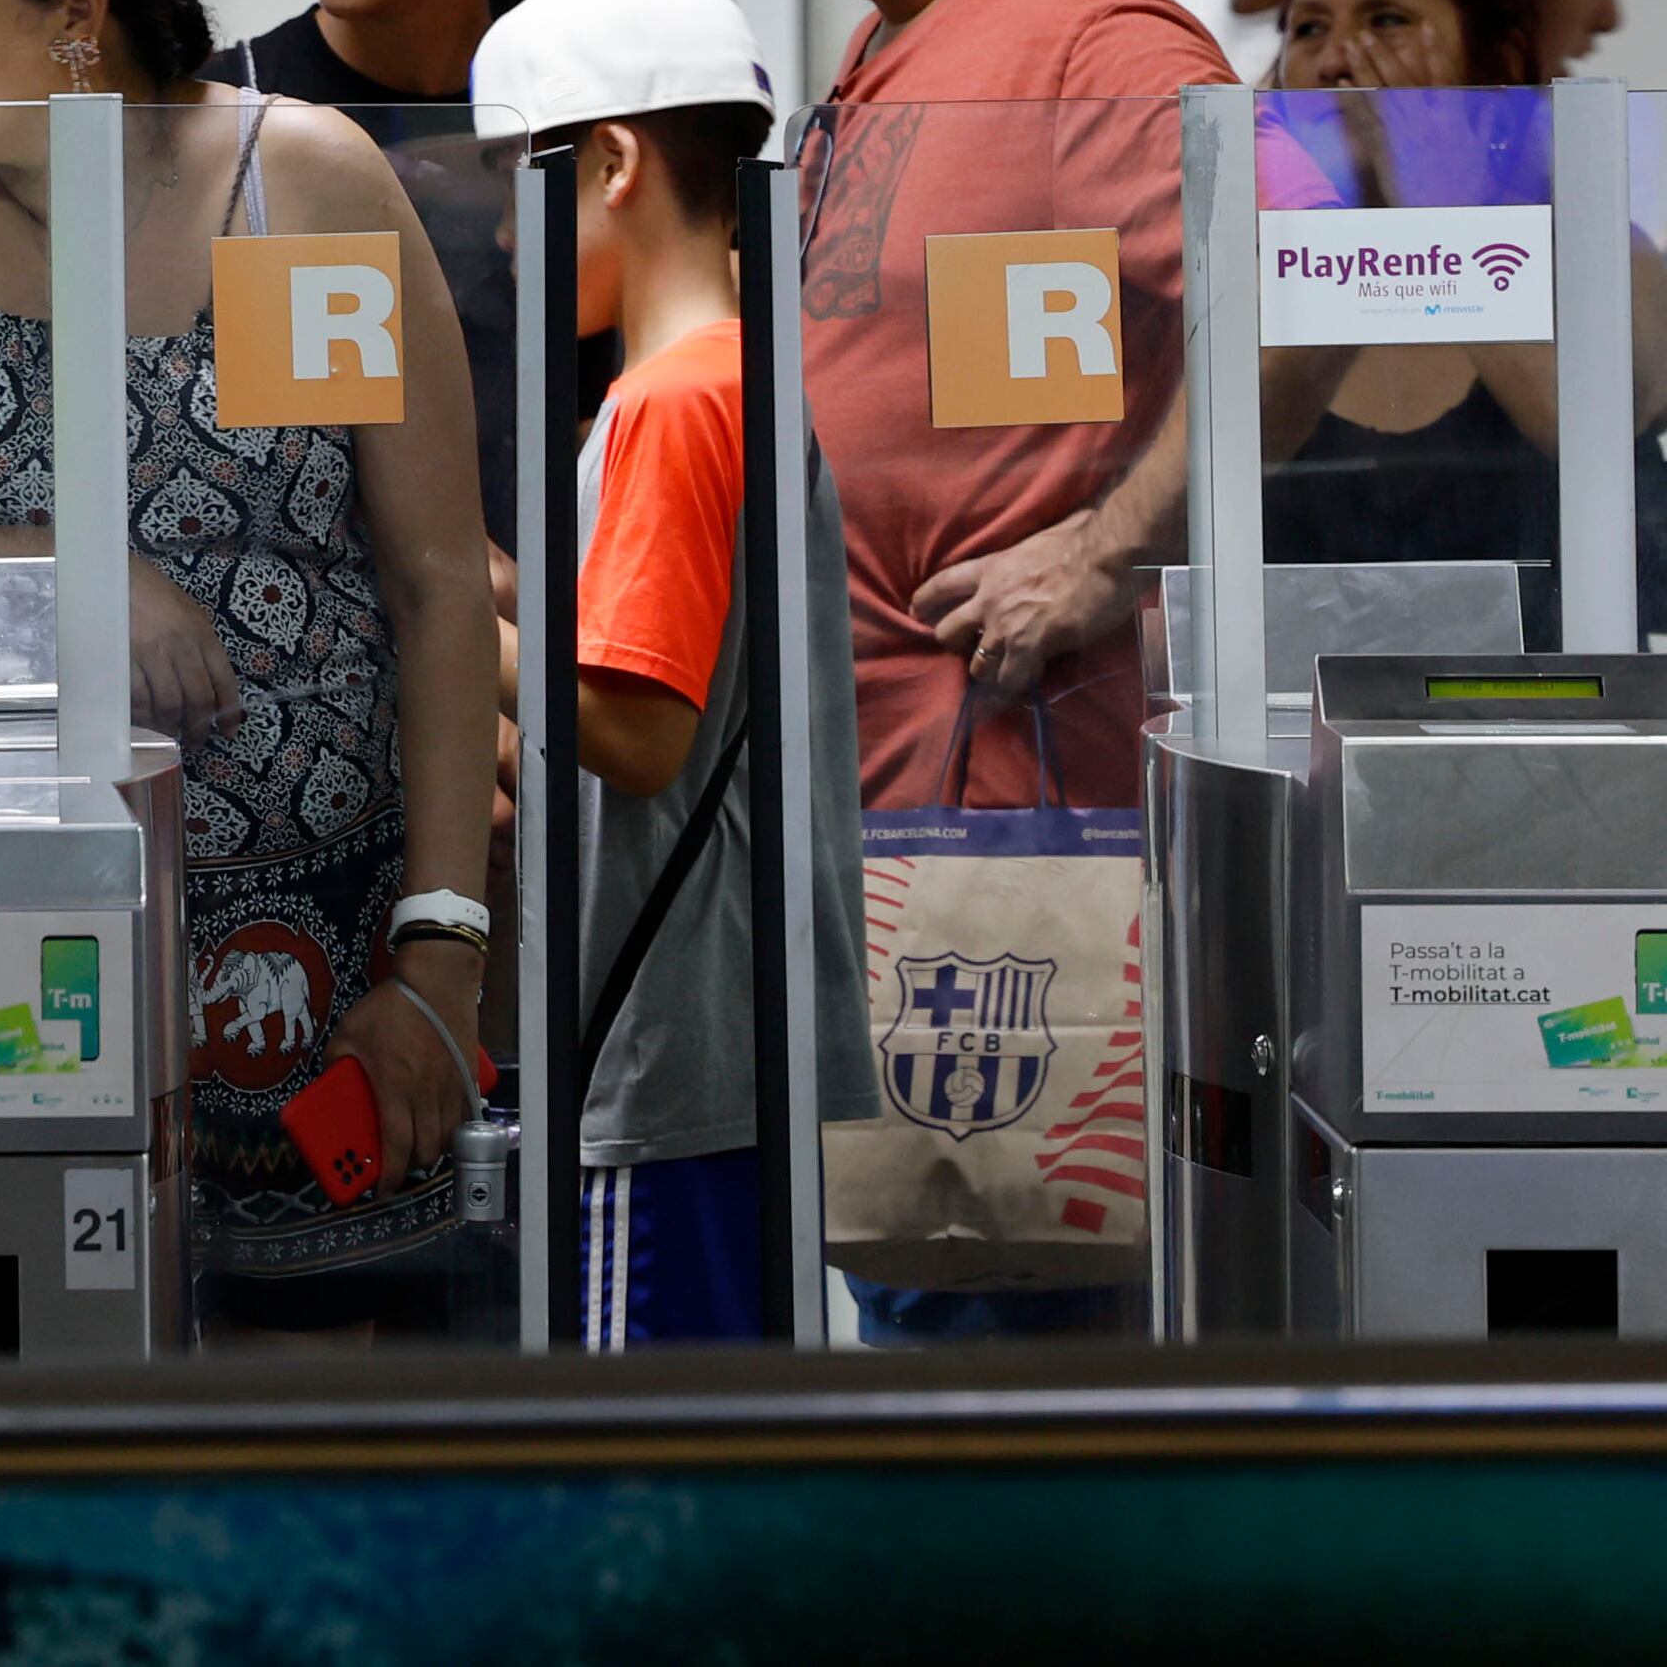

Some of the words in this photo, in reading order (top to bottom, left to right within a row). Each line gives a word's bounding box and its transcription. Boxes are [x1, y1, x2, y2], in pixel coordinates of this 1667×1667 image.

[1277, 244, 1463, 286] PlayRenfe
[1358, 281, 1390, 298] Más
[1395, 285, 1425, 300] que
[1429, 279, 1458, 297] wifi
[289, 264, 398, 381] R
[1005, 261, 1117, 379] R
[1390, 942, 1463, 960] Passa't
[1469, 946, 1482, 960] a
[1488, 942, 1505, 960] la
[1390, 964, 1507, 982] T-mobilitat
[1513, 968, 1525, 982] a
[1390, 985, 1551, 1004] T-mobilitat.cat
[936, 1031, 1001, 1052] FCB
[72, 1207, 126, 1253] 21
